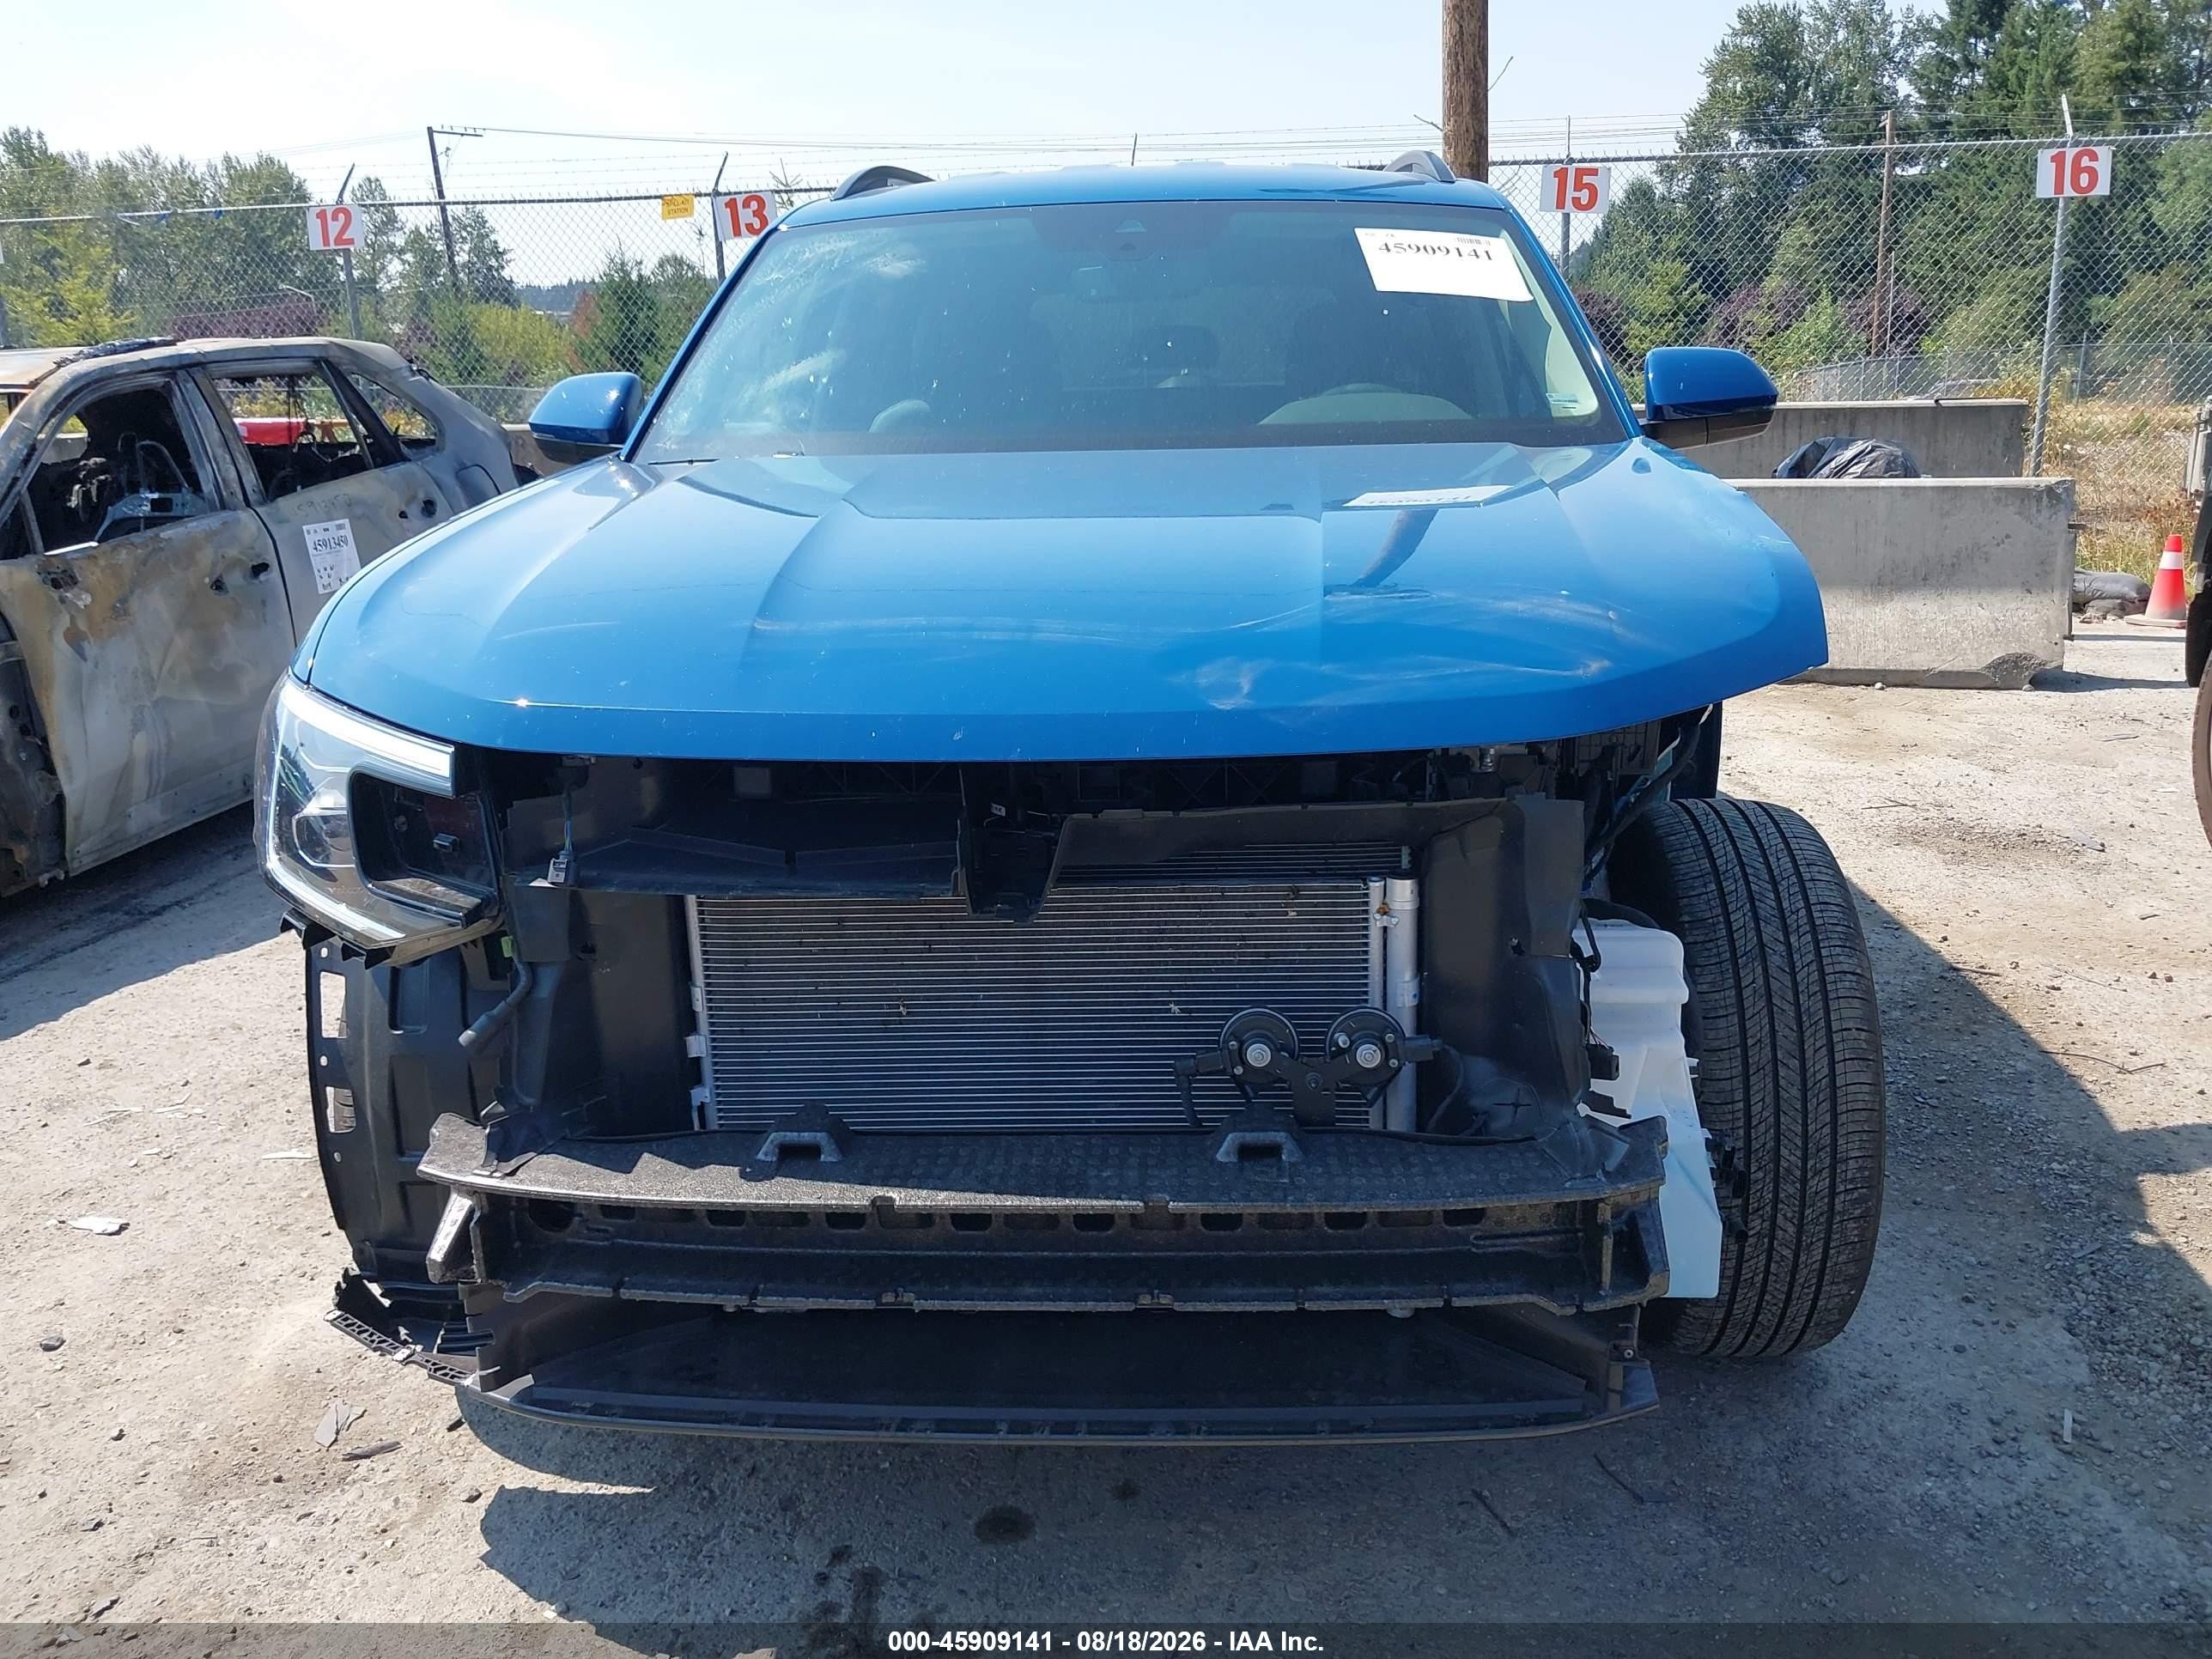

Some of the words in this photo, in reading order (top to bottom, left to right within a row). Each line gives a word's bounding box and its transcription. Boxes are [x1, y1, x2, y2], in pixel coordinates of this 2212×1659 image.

[1553, 167, 1599, 212] 15
[2050, 148, 2100, 196] 16
[315, 206, 356, 247] 12
[724, 194, 769, 238] 13
[1378, 241, 1492, 261] 45909141
[313, 534, 349, 553] 45913450
